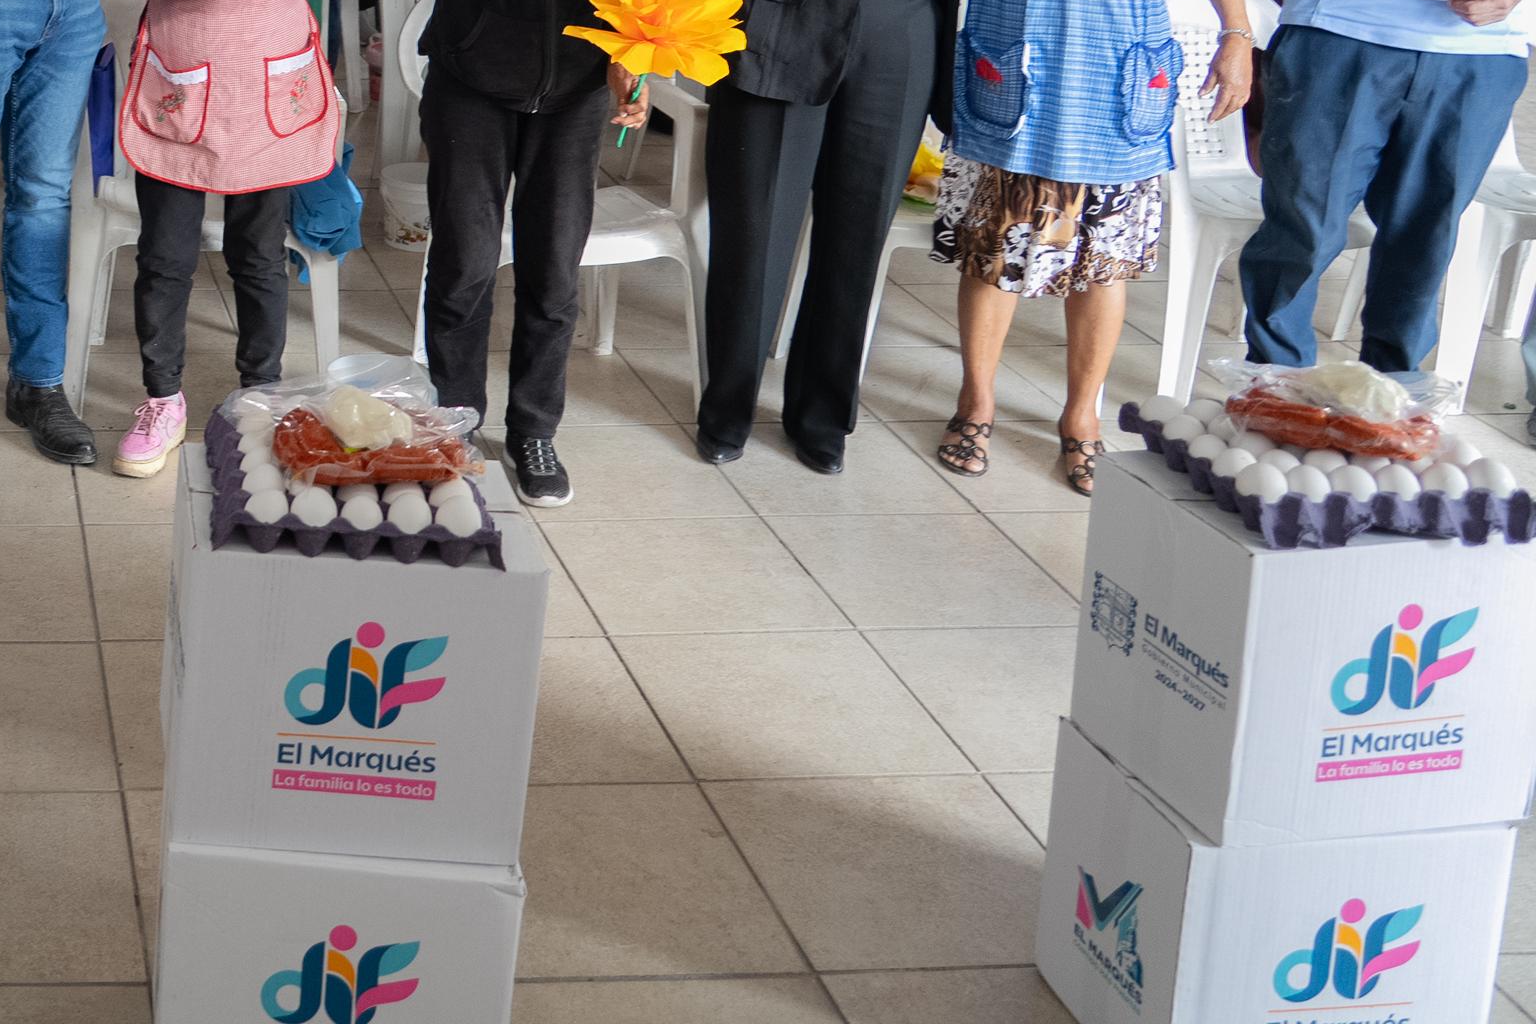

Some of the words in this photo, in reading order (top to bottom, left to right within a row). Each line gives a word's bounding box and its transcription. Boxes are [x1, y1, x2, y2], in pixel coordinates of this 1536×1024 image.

[1144, 613, 1159, 637] El
[1160, 625, 1229, 688] Marqués
[1321, 734, 1345, 757] El
[1351, 723, 1464, 755] Marqués
[277, 742, 302, 764] El
[310, 744, 436, 773] Marqués
[1318, 766, 1337, 778] La
[1339, 761, 1389, 777] familia
[1392, 759, 1406, 772] lo
[1408, 758, 1424, 770] es
[1426, 754, 1460, 768] todo
[274, 773, 295, 786] La
[298, 774, 354, 791] familia
[356, 779, 371, 792] lo
[374, 782, 392, 794] es
[395, 782, 433, 797] todo
